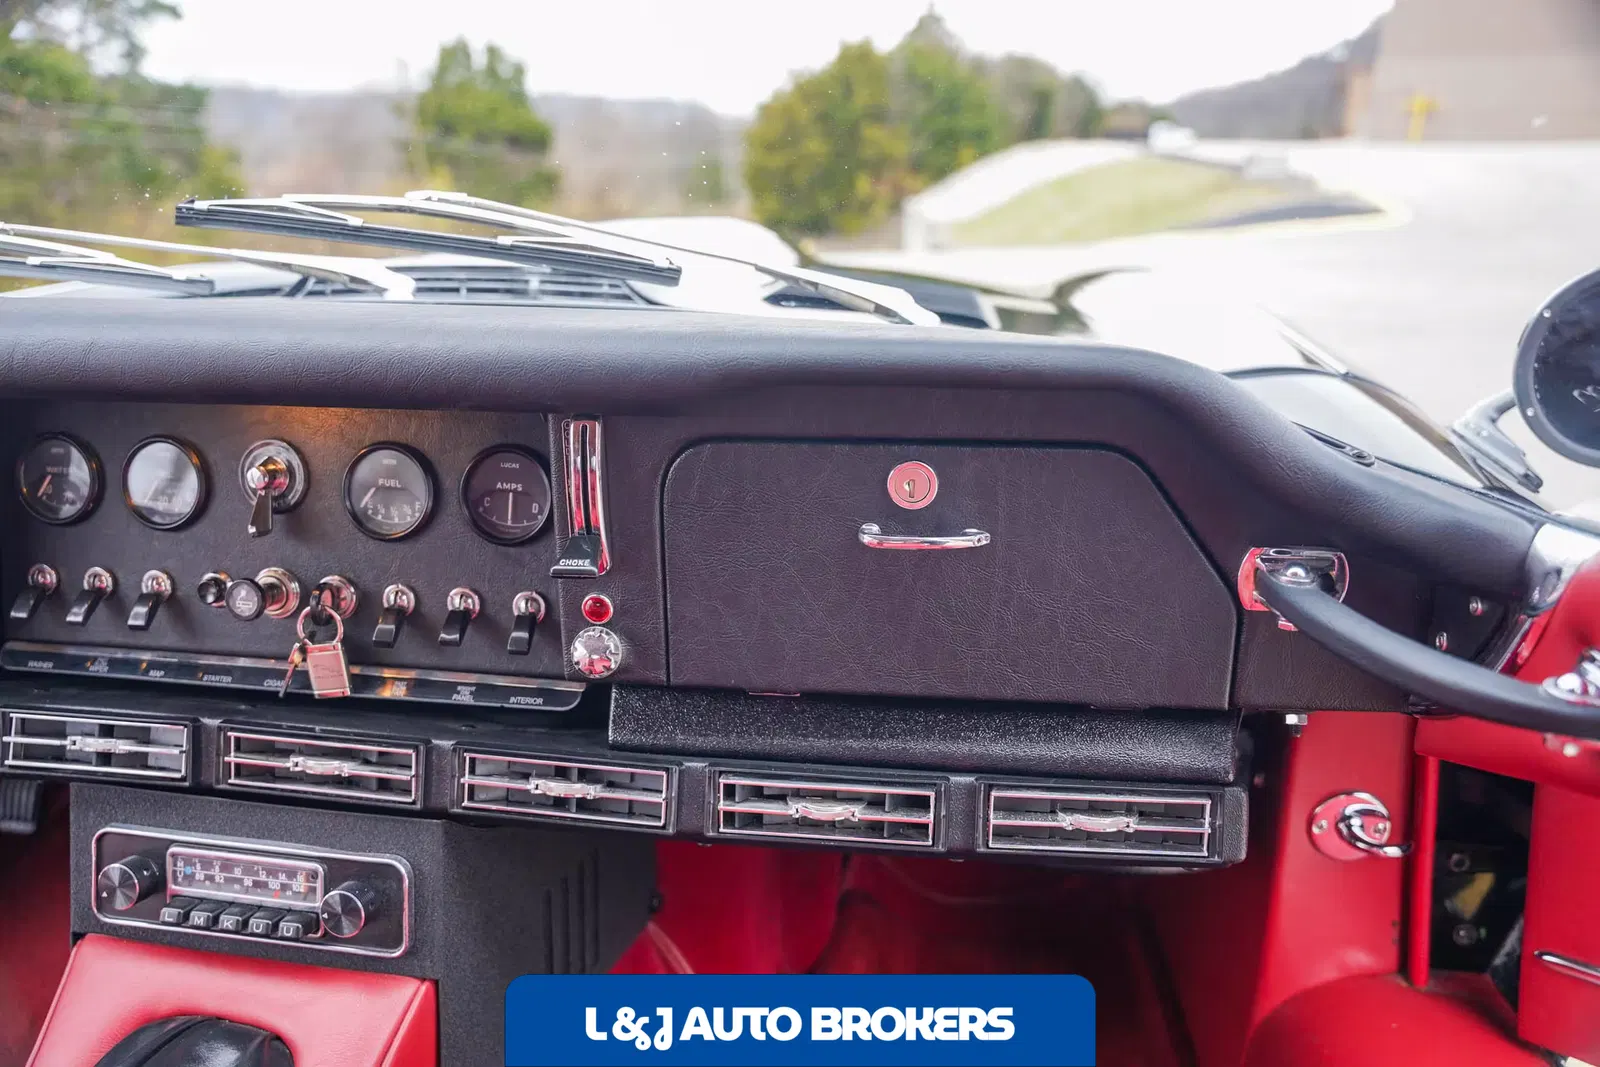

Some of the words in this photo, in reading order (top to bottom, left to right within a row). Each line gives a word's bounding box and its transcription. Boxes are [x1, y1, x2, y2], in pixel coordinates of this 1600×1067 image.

[378, 478, 401, 488] FUEL
[496, 482, 522, 491] AMPS
[415, 501, 421, 511] F
[484, 497, 491, 507] C
[532, 503, 539, 513] D
[202, 674, 233, 683] STARTER
[452, 694, 474, 702] PANEL
[509, 696, 544, 705] INTERIOR
[234, 867, 242, 875] 10
[259, 868, 267, 879] 12
[279, 872, 286, 880] 14
[214, 874, 224, 883] 92
[243, 878, 253, 887] 96
[268, 881, 280, 890] 100
[164, 911, 174, 921] L
[194, 916, 204, 926] M
[223, 919, 234, 930] K
[253, 922, 263, 933] U
[283, 925, 293, 936] U
